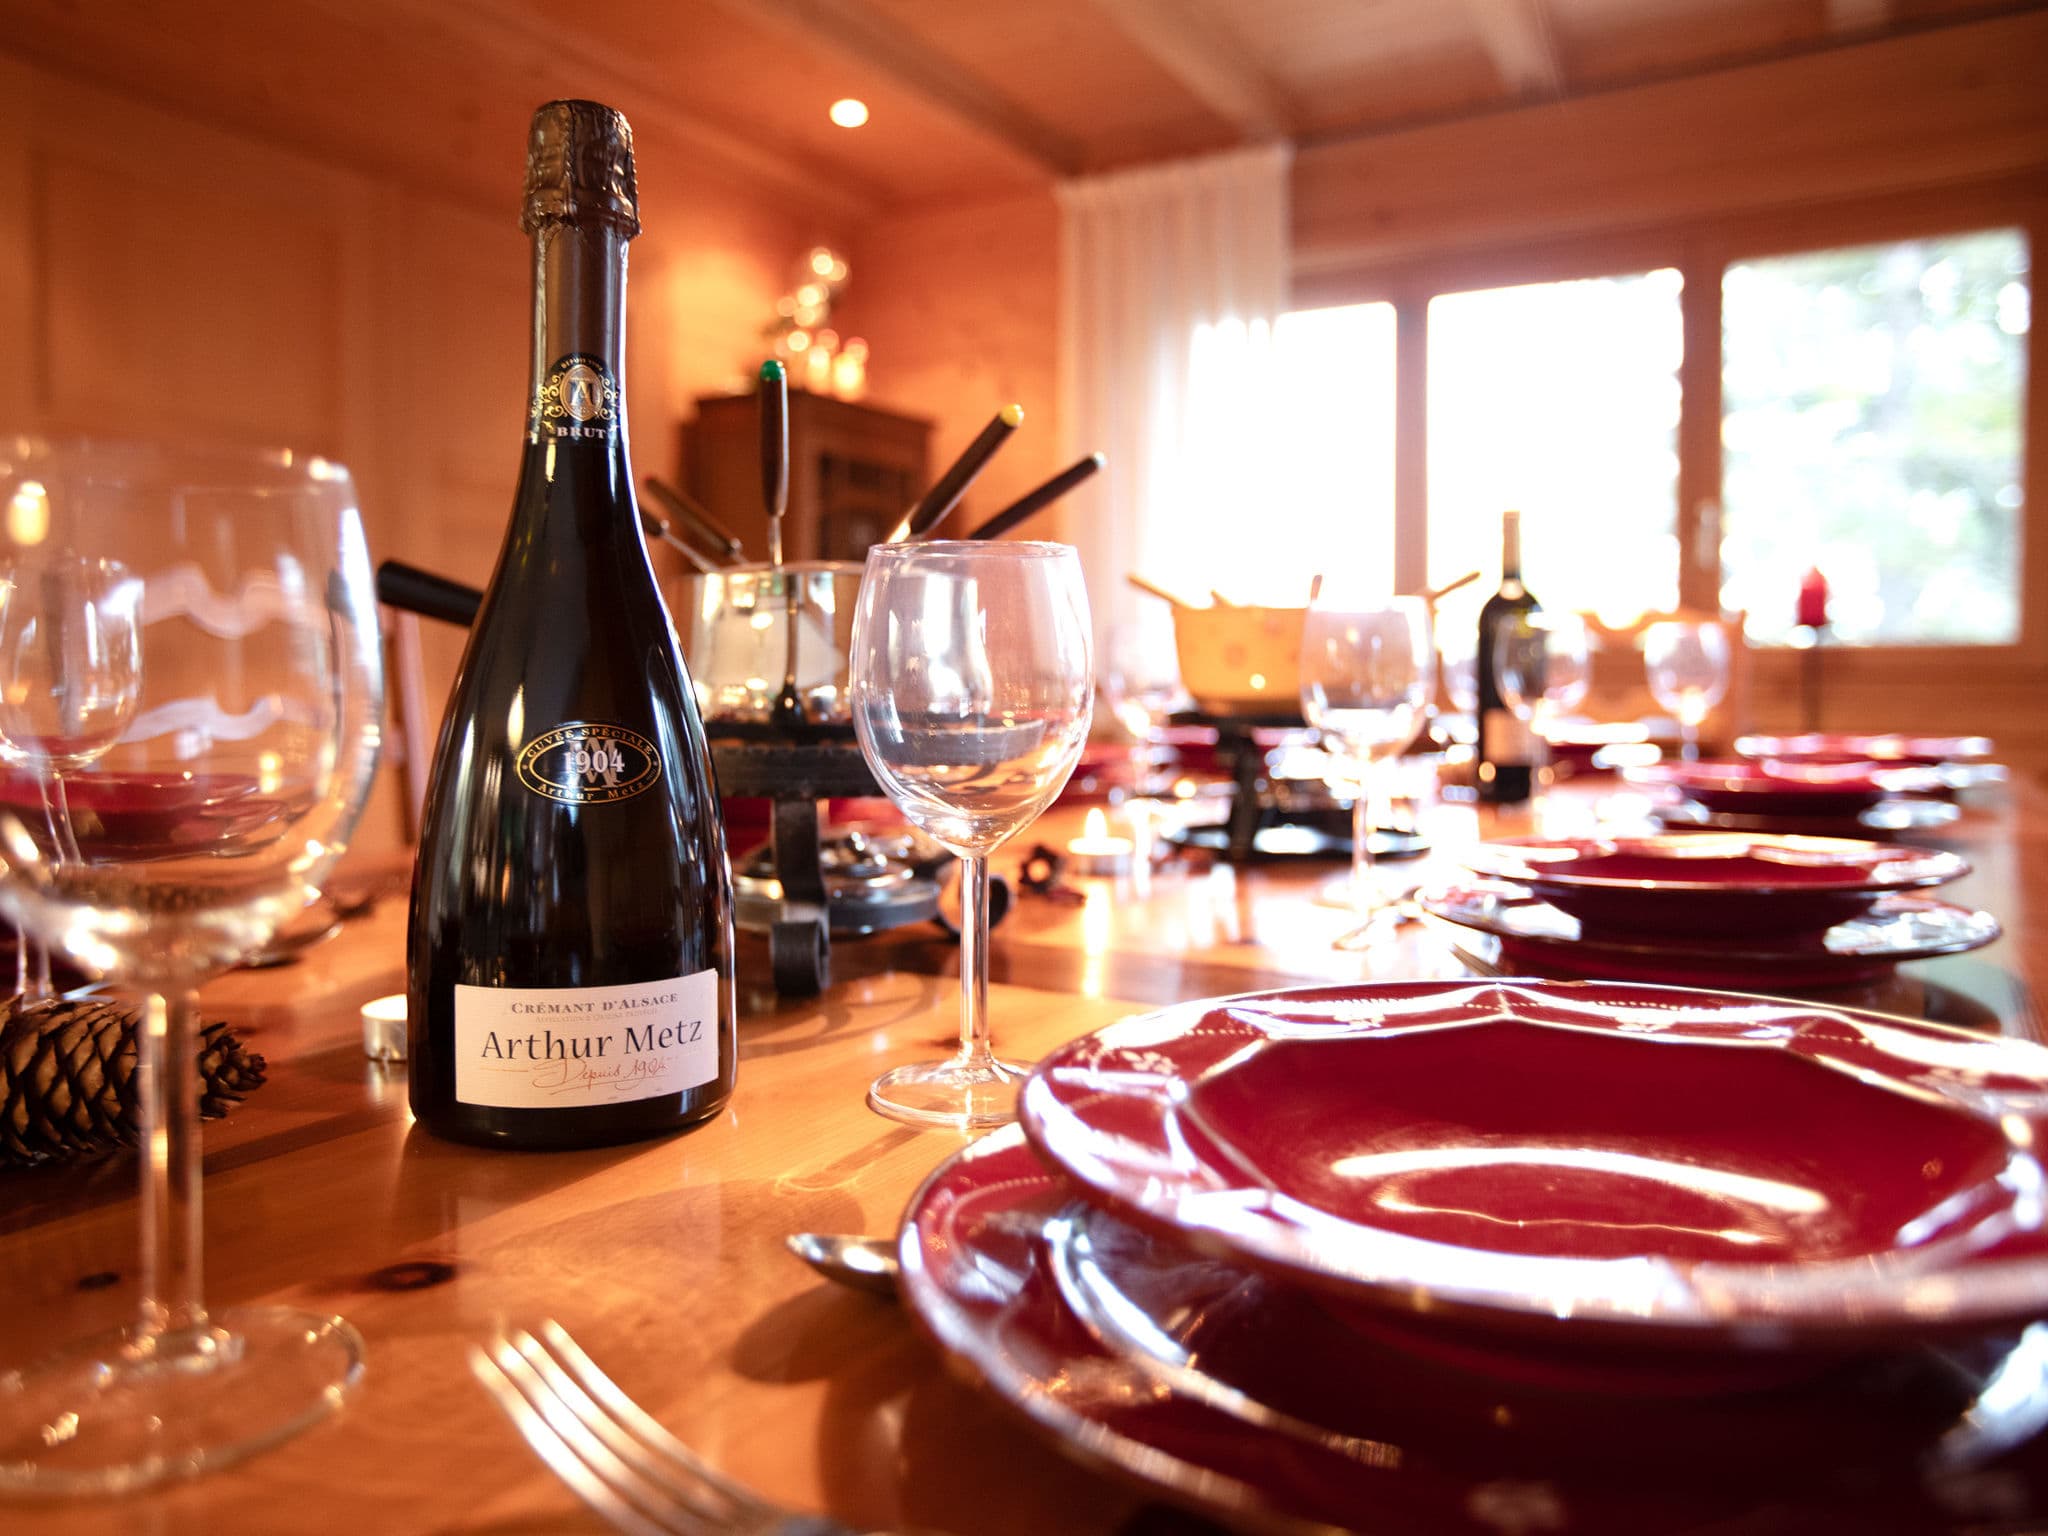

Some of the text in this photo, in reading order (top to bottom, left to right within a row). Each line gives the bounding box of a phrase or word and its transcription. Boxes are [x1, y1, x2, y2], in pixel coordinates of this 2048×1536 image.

[557, 426, 607, 439] BRUT
[526, 727, 652, 758] CUVÉE SPÉCIALE
[563, 748, 625, 773] 1904
[538, 782, 644, 801] Arthur Metz
[511, 993, 678, 1014] CRÉMANT D'ALSACE
[481, 1019, 702, 1060] Arthur Metz
[532, 1057, 621, 1090] Depuis
